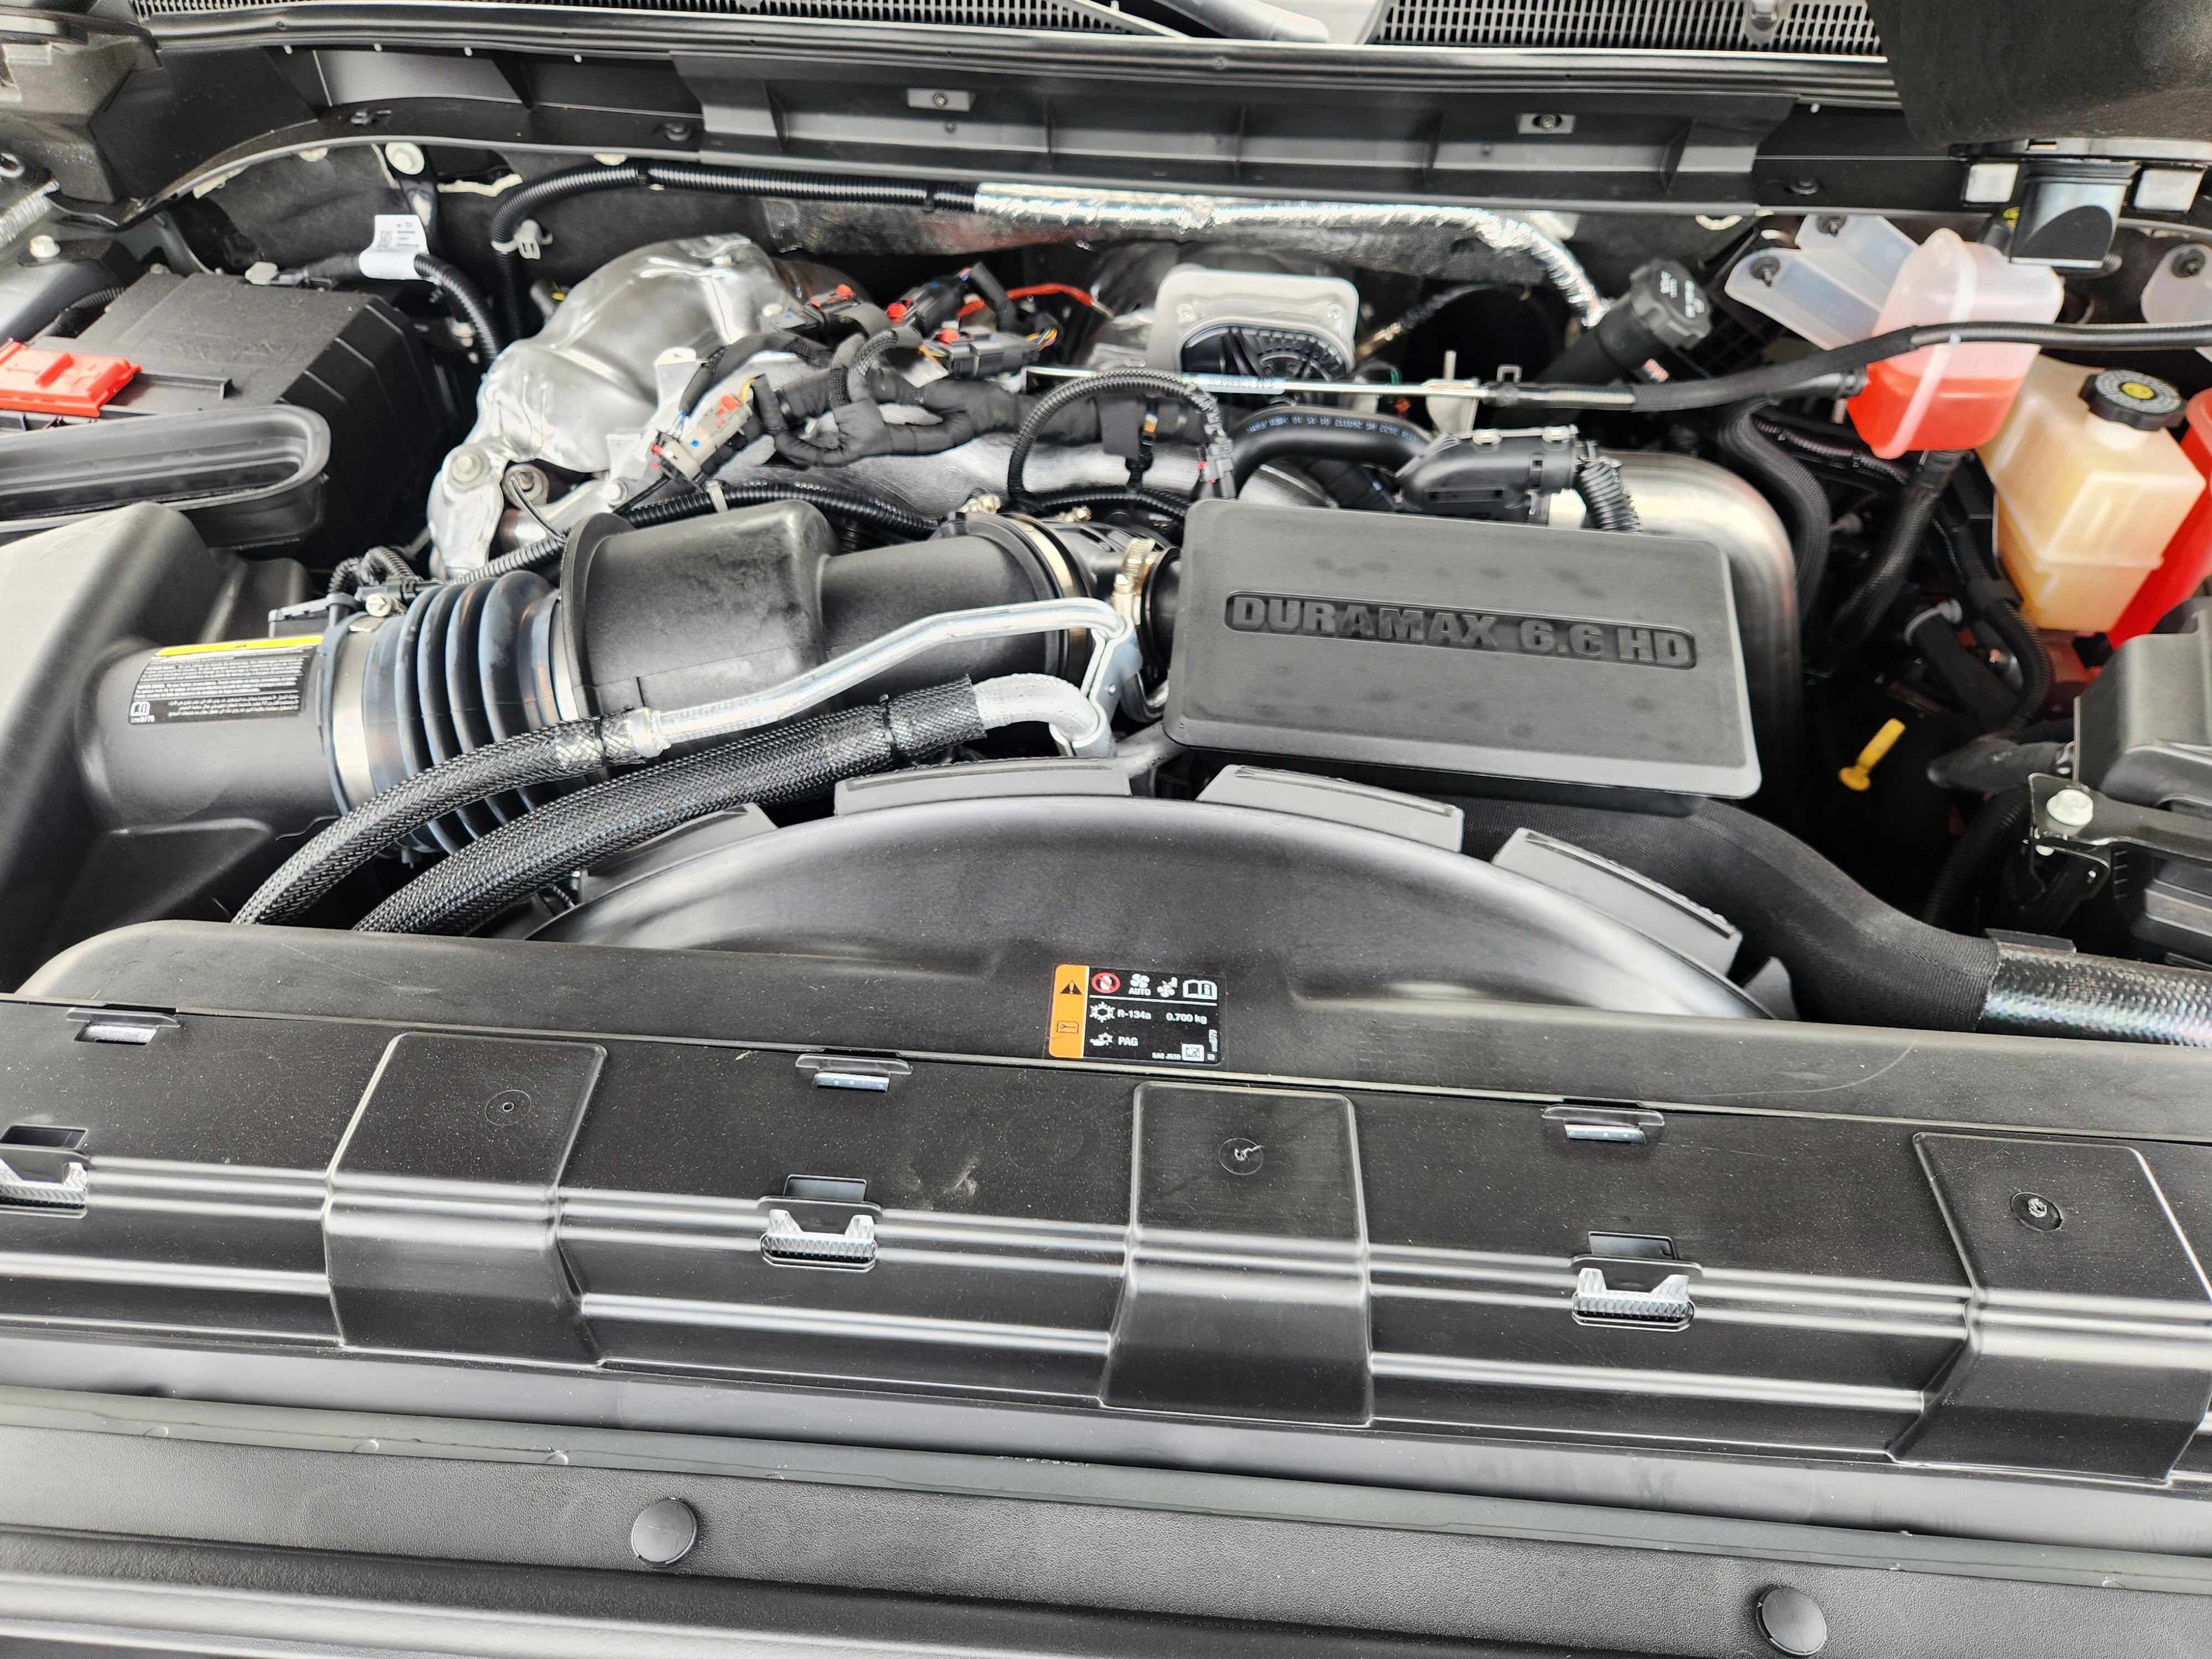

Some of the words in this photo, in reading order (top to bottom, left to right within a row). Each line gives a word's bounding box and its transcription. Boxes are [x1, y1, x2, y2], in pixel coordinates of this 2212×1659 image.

[1232, 596, 1498, 648] DURAMAX
[1520, 619, 1603, 656] 6.6
[1618, 626, 1690, 666] HD
[1128, 988, 1151, 996] AUTO
[1117, 1009, 1152, 1020] R-134a
[1166, 1013, 1193, 1022] 0.700
[1194, 1014, 1208, 1025] kg
[1118, 1036, 1139, 1046] PAG
